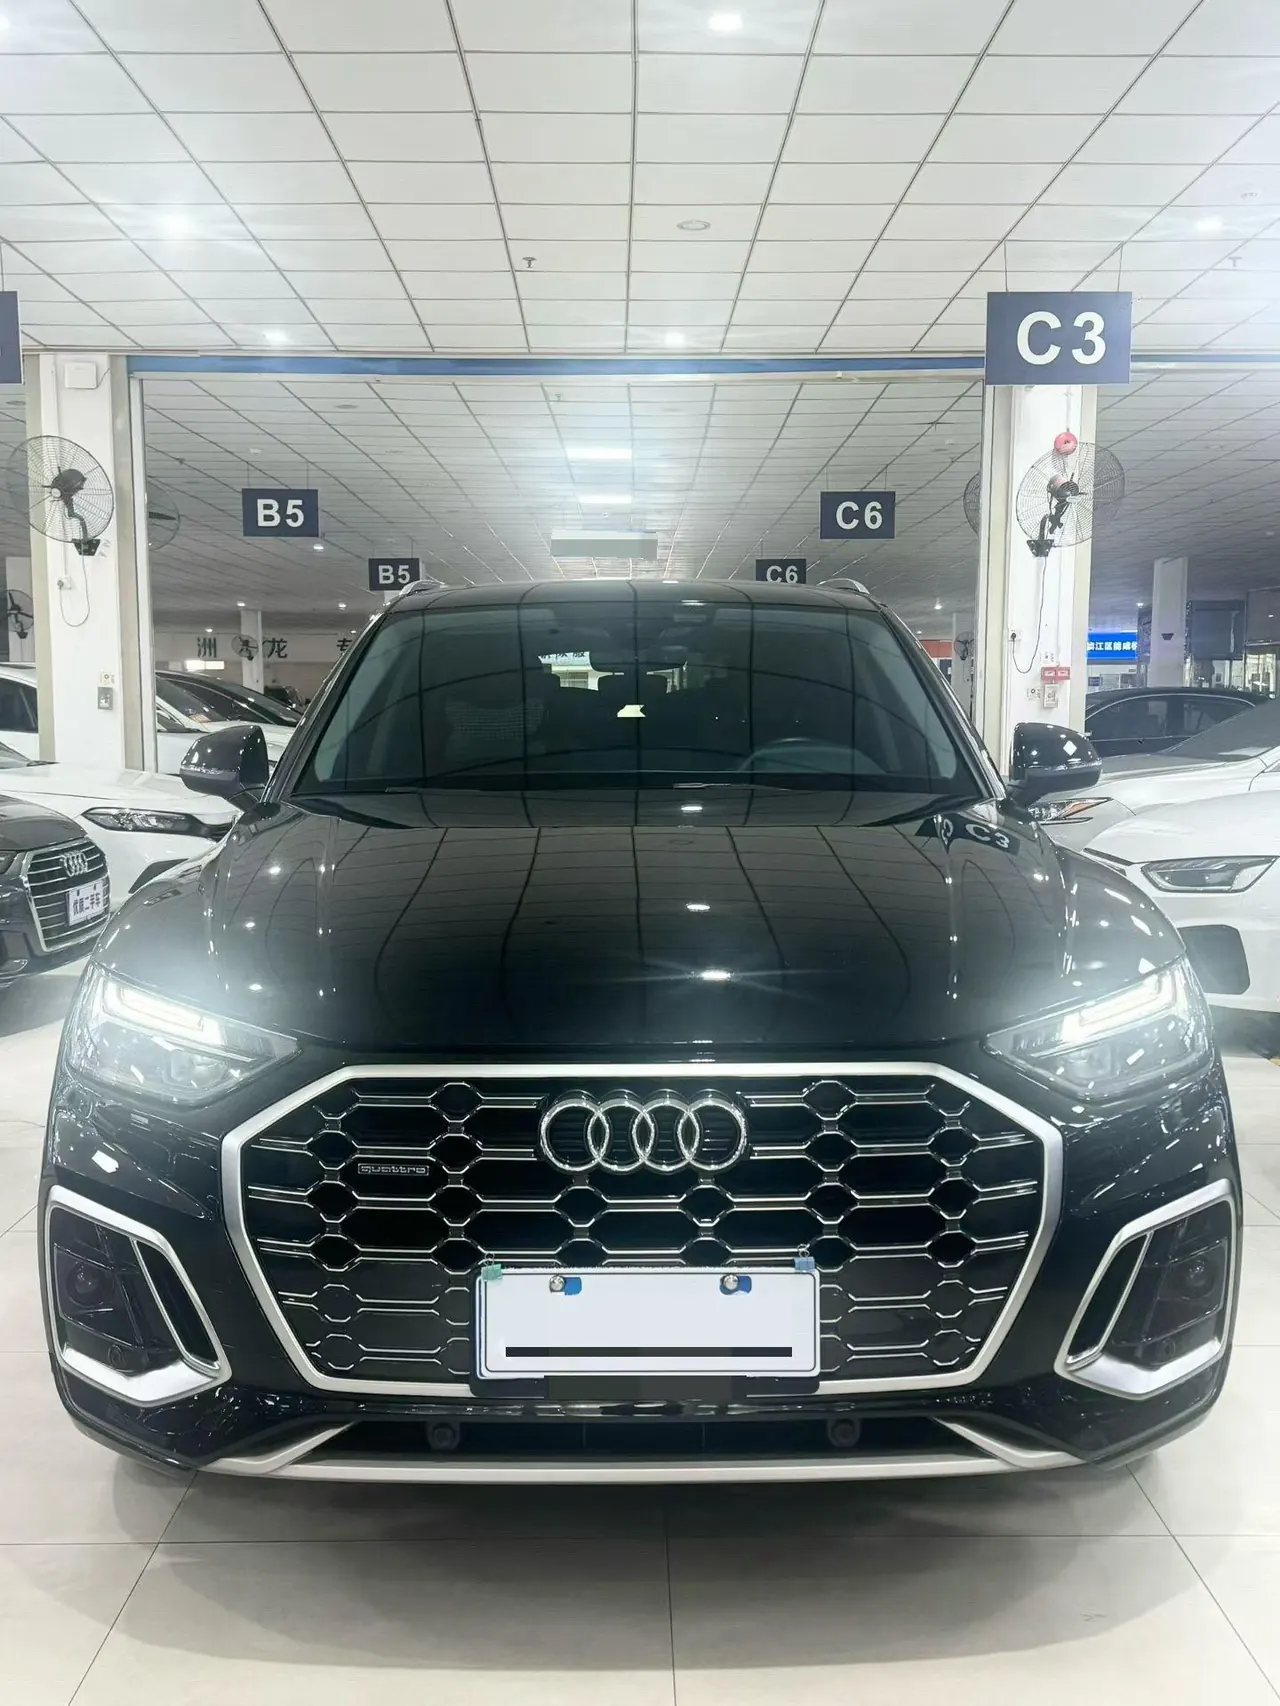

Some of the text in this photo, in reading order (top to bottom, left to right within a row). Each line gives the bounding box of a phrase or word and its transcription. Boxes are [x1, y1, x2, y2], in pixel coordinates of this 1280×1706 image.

[1016, 310, 1107, 366] C3
[256, 498, 305, 528] B5
[835, 500, 883, 530] C6
[377, 564, 411, 585] B5
[766, 565, 799, 584] C6
[360, 1165, 427, 1174] quattro
